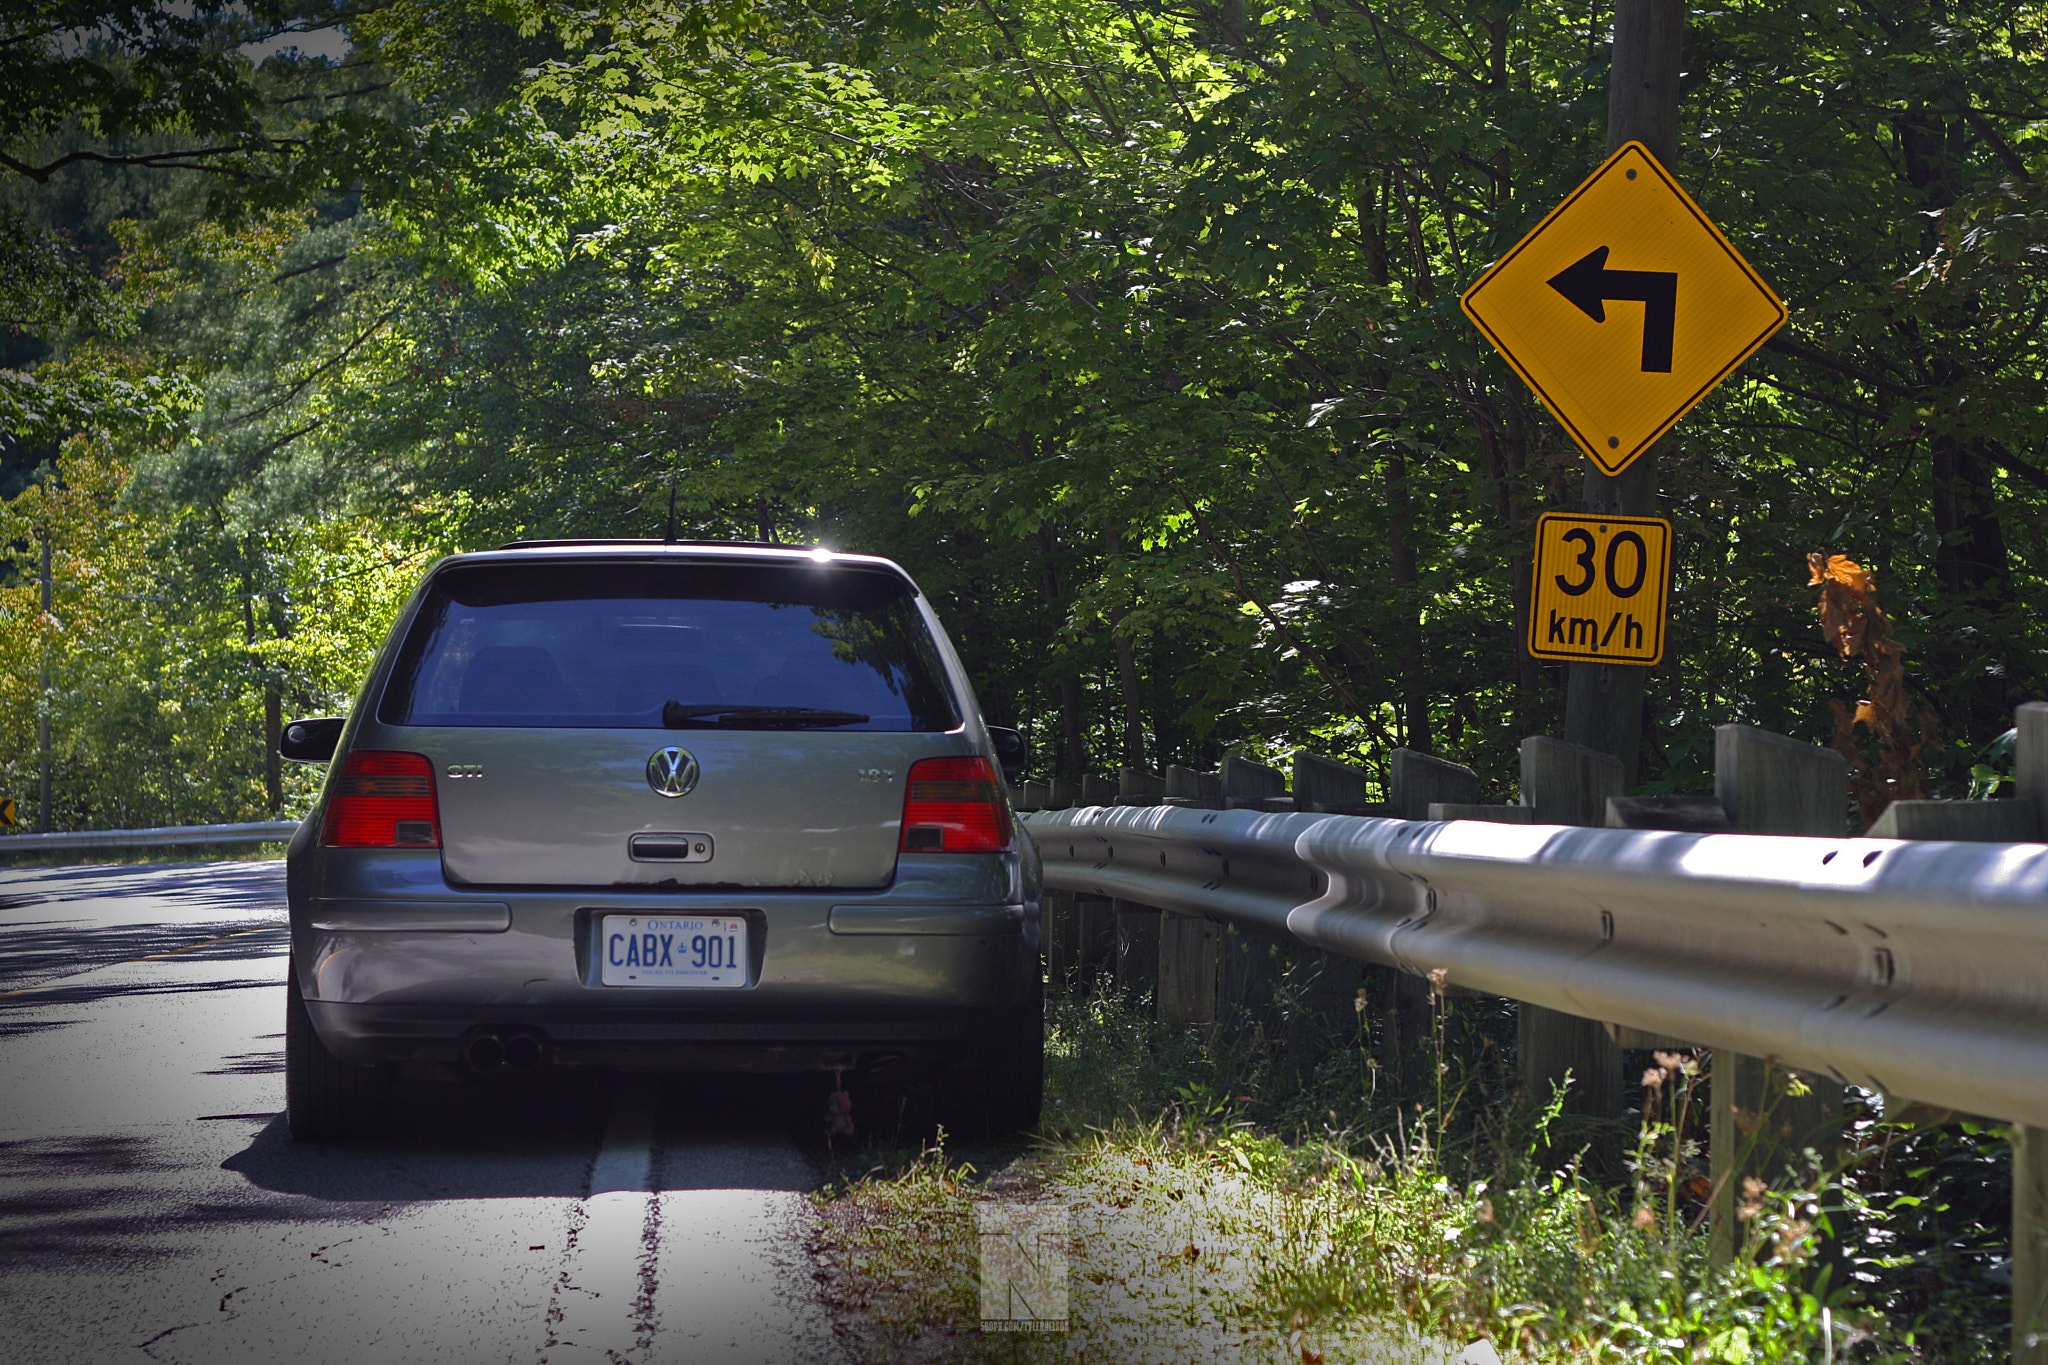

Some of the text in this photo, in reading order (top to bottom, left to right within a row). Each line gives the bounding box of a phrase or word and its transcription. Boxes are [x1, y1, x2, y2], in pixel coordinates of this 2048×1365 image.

[1555, 528, 1647, 598] 30
[1548, 608, 1643, 650] km/h
[447, 764, 483, 778] GTI
[609, 933, 737, 968] CABX 901
